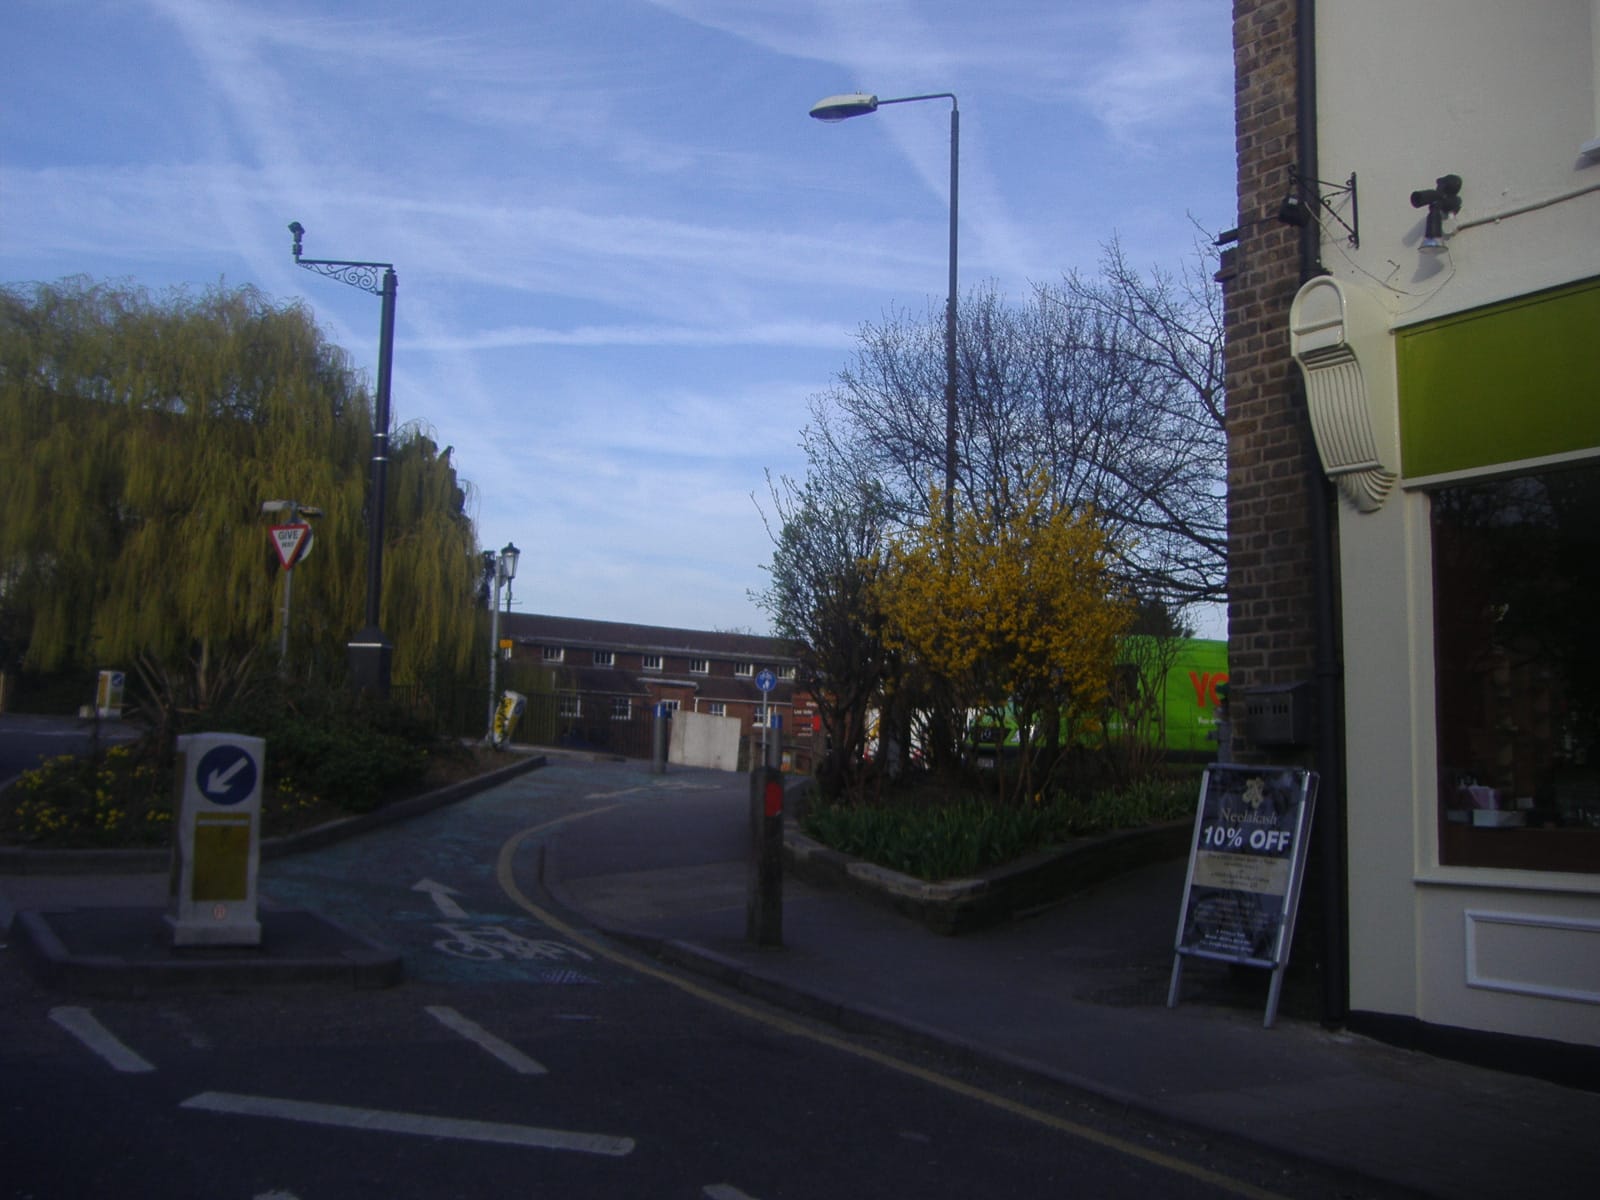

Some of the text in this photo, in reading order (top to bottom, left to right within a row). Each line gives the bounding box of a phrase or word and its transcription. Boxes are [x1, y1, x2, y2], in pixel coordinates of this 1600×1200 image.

[279, 531, 298, 540] GIVE
[1204, 825, 1291, 852] 10% OFF
